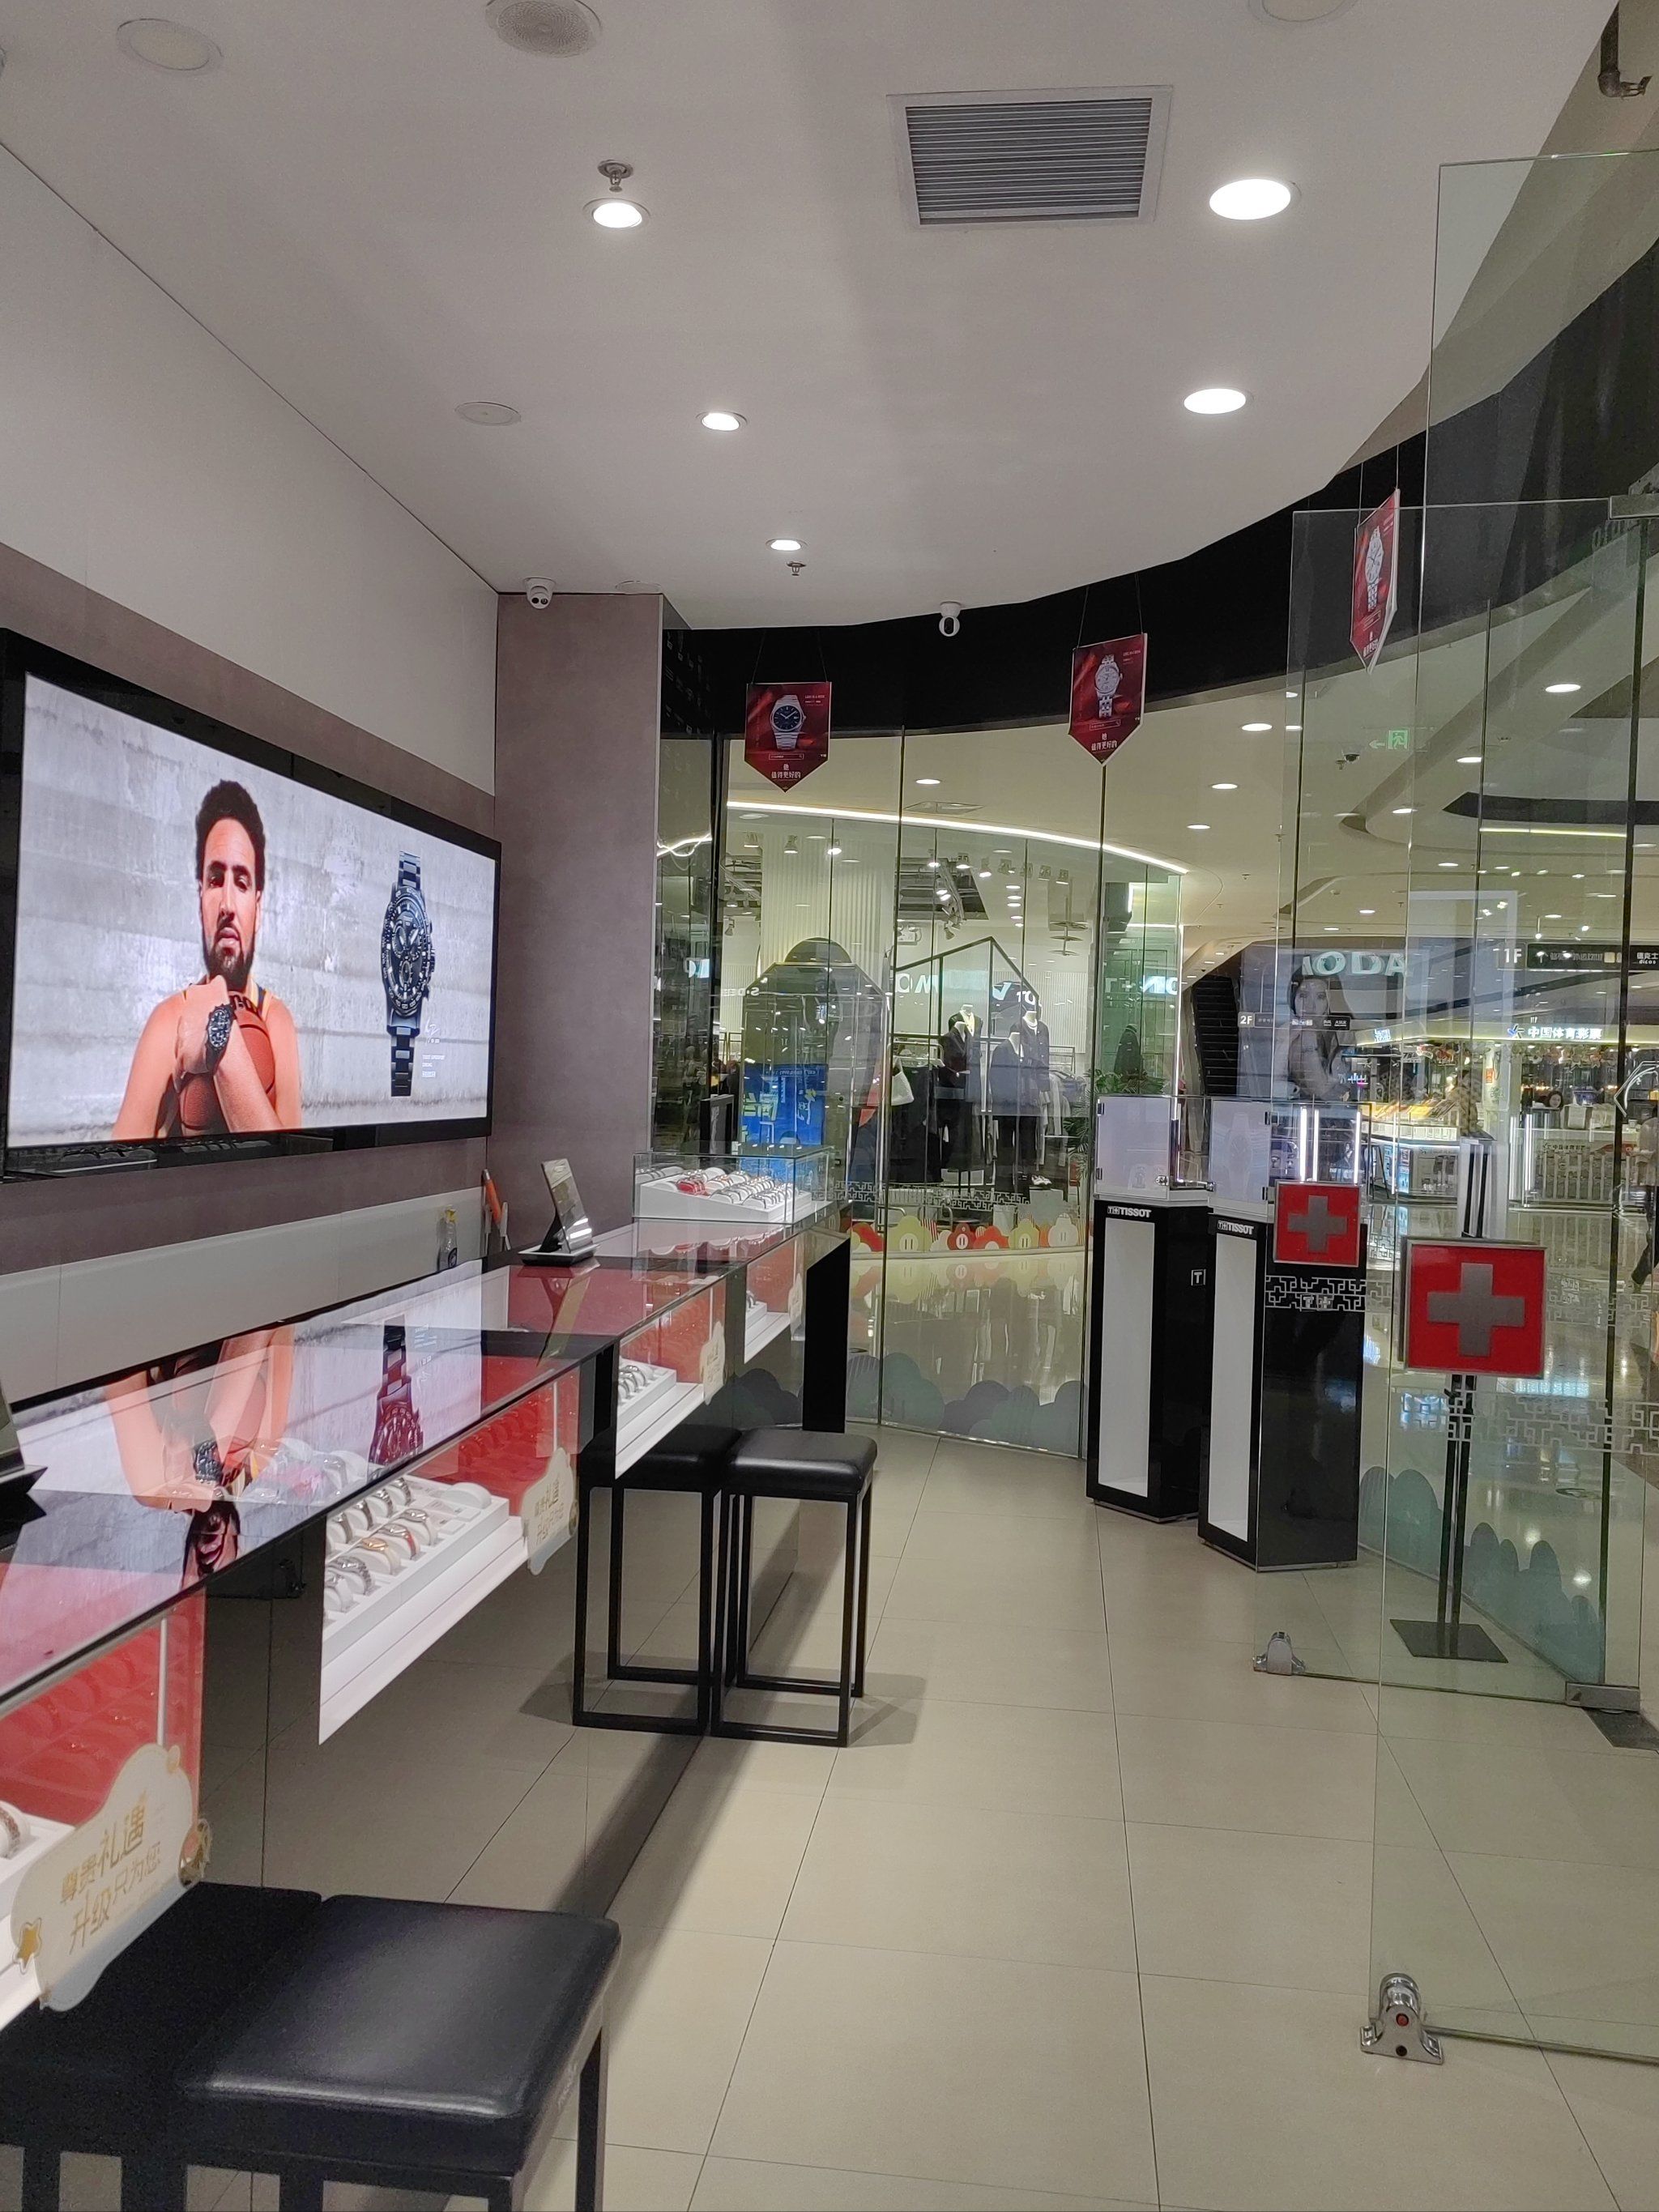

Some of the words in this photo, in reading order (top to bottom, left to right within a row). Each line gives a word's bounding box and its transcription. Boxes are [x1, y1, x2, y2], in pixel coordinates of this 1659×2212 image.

[1239, 1016, 1253, 1025] 2F
[1528, 1025, 1603, 1040] 中国体育彩票
